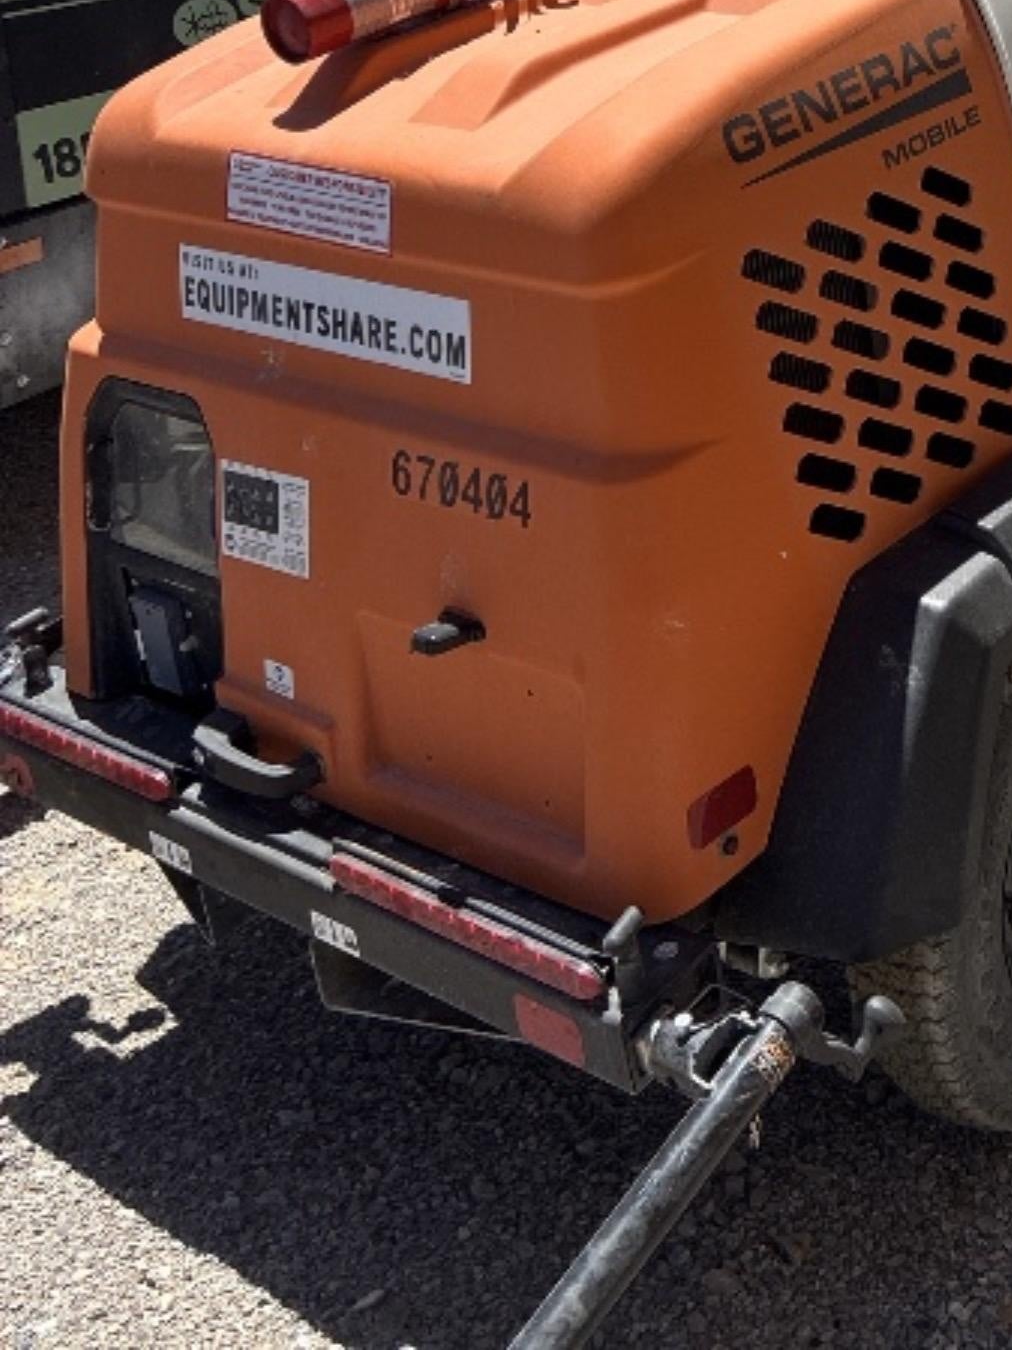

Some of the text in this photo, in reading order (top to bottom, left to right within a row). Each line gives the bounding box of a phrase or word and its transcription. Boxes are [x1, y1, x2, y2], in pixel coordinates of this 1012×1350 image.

[722, 26, 961, 163] GENERAC
[32, 132, 90, 184] 18
[881, 104, 982, 169] MOBILE
[182, 251, 214, 271] VISIT
[218, 259, 235, 276] US
[184, 275, 466, 370] EQUIPMENTSHARE.COM
[391, 449, 532, 528] 670404
